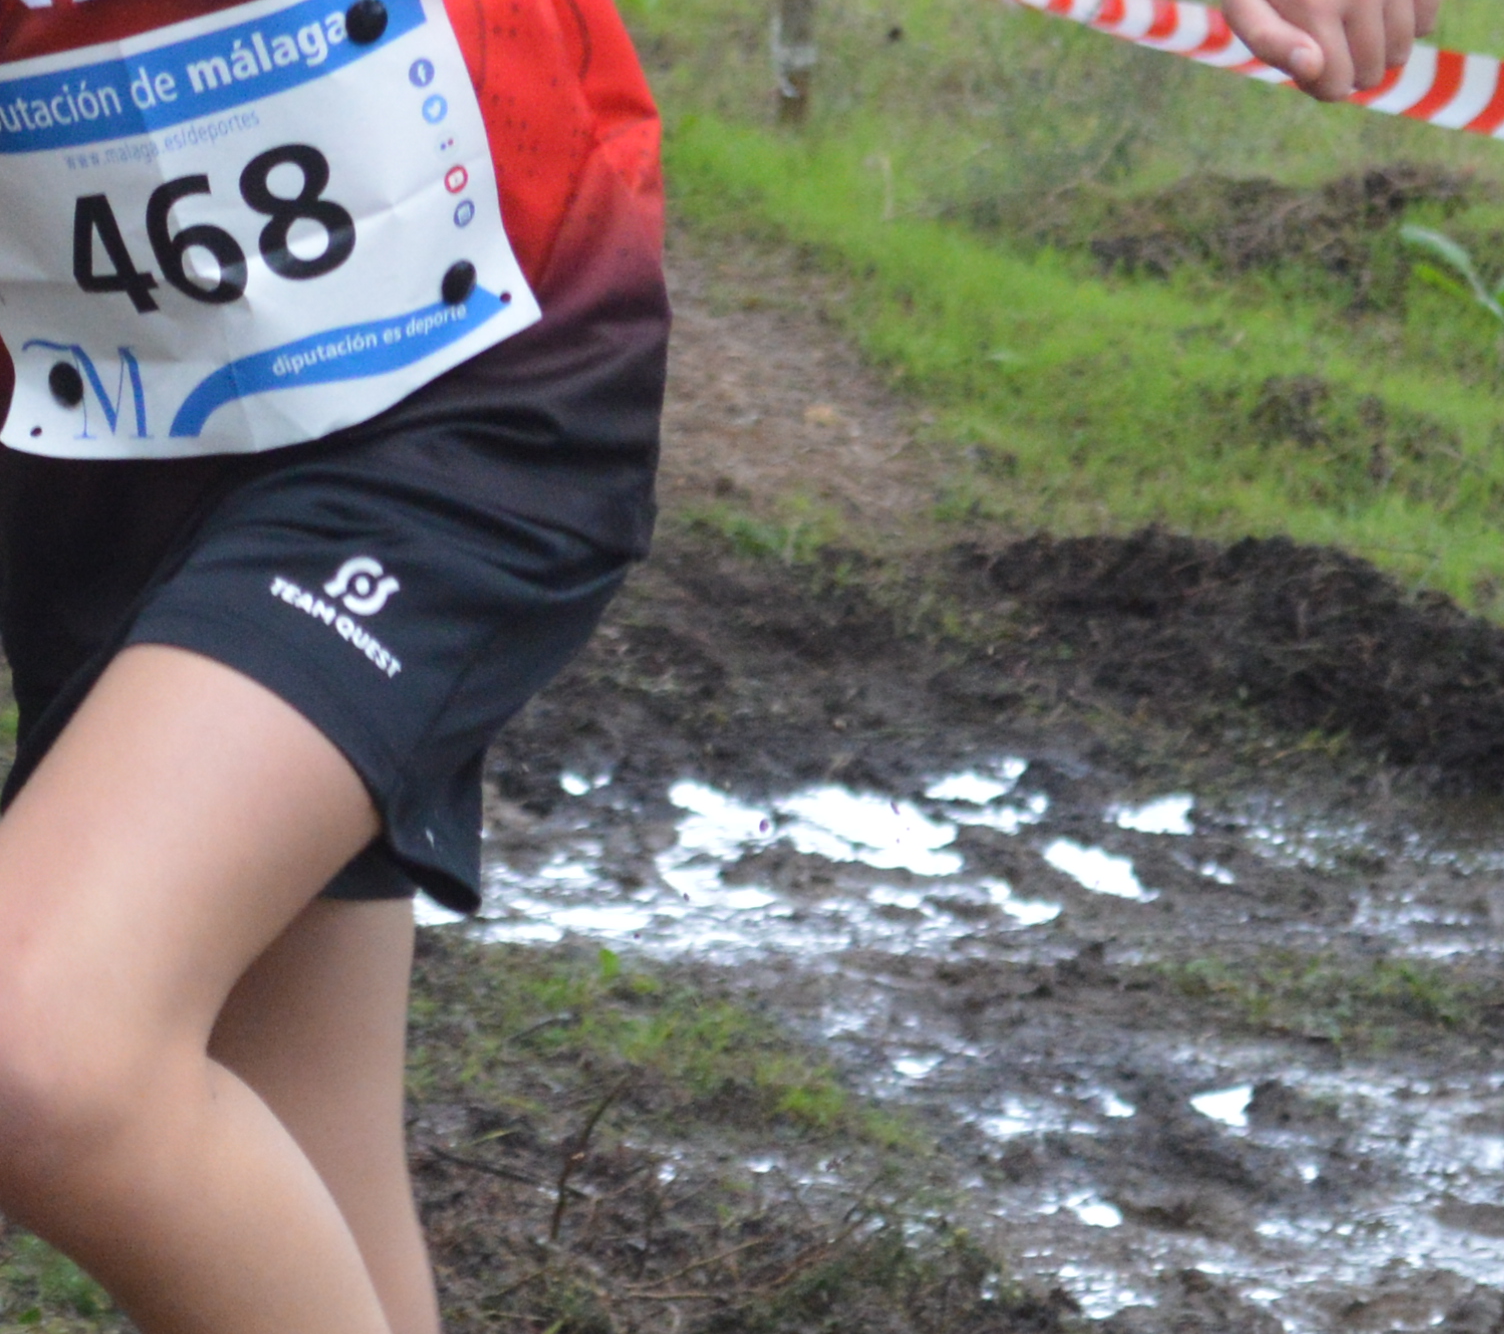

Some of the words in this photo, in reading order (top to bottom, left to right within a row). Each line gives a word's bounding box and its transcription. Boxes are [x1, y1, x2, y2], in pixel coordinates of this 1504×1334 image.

[130, 66, 179, 111] de
[186, 10, 348, 94] málaga
[72, 142, 357, 315] 468
[271, 331, 378, 376] diputación
[382, 325, 403, 345] es
[405, 301, 467, 339] deporte
[269, 576, 337, 627] TEAM
[334, 614, 403, 680] QUEST
